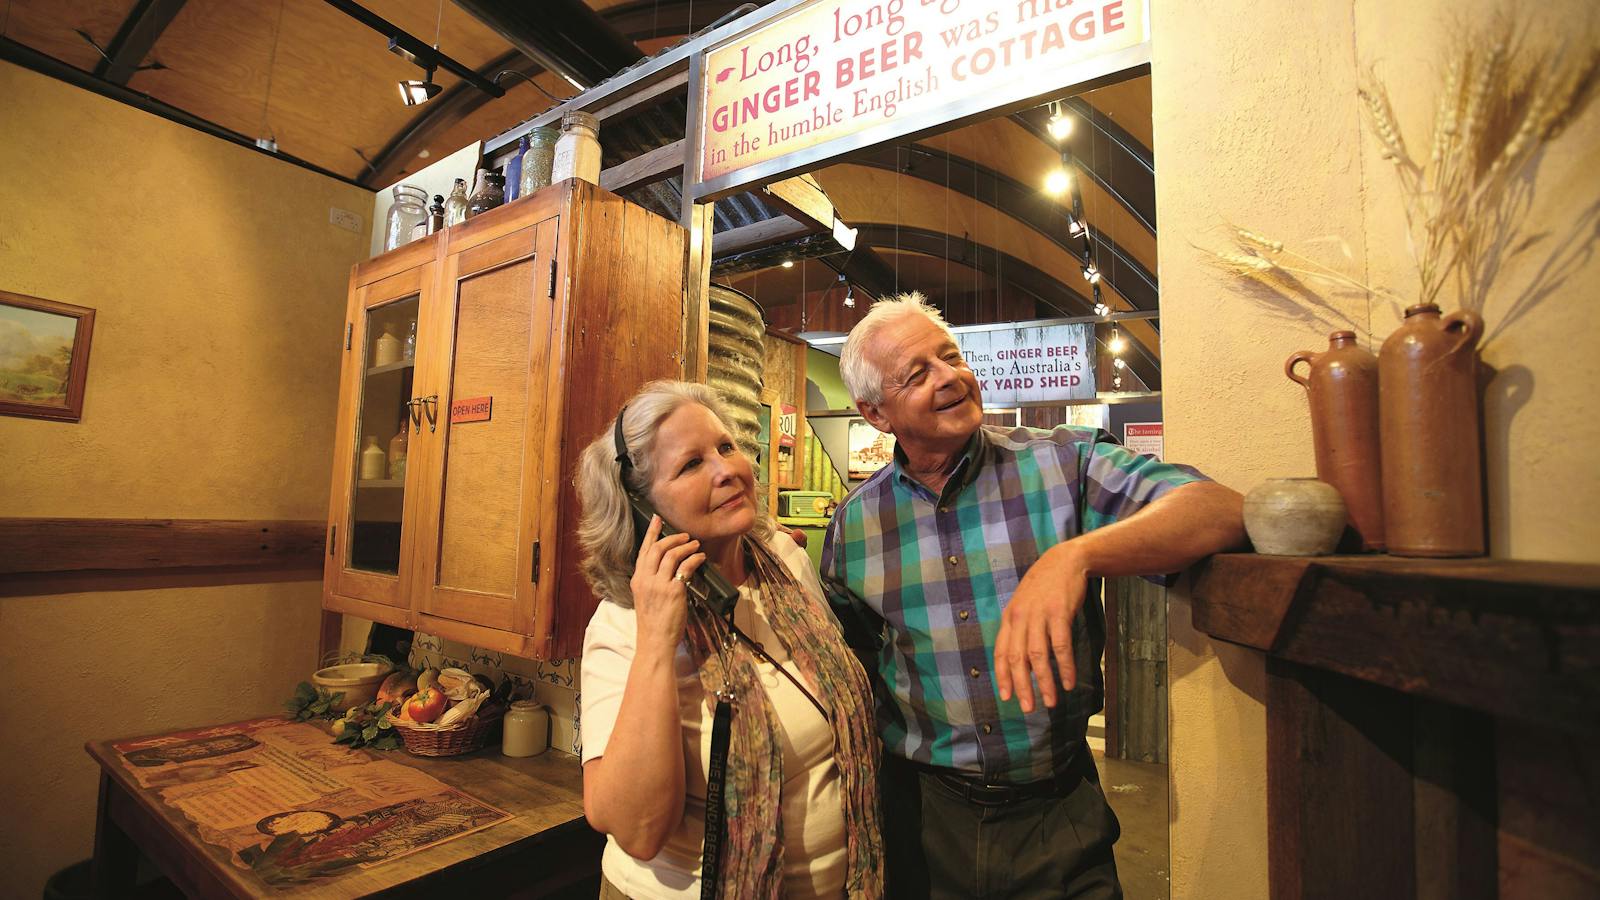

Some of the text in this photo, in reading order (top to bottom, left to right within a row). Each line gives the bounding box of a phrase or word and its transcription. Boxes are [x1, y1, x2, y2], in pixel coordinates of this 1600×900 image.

[740, 0, 904, 73] Long, long
[712, 70, 820, 133] GINGER
[836, 31, 923, 89] BEER
[940, 10, 999, 49] was
[711, 0, 1125, 166] in the humble English COTTAGE
[962, 345, 1078, 363] Then, GINGER BEER
[992, 366, 1004, 376] to
[1010, 356, 1081, 375] Australia's
[994, 378, 1034, 390] YARD
[1040, 375, 1082, 388] SHED
[453, 403, 489, 416] OPEN HERE
[780, 415, 796, 437] ROL
[710, 752, 722, 778] THE
[701, 879, 713, 900] BA
